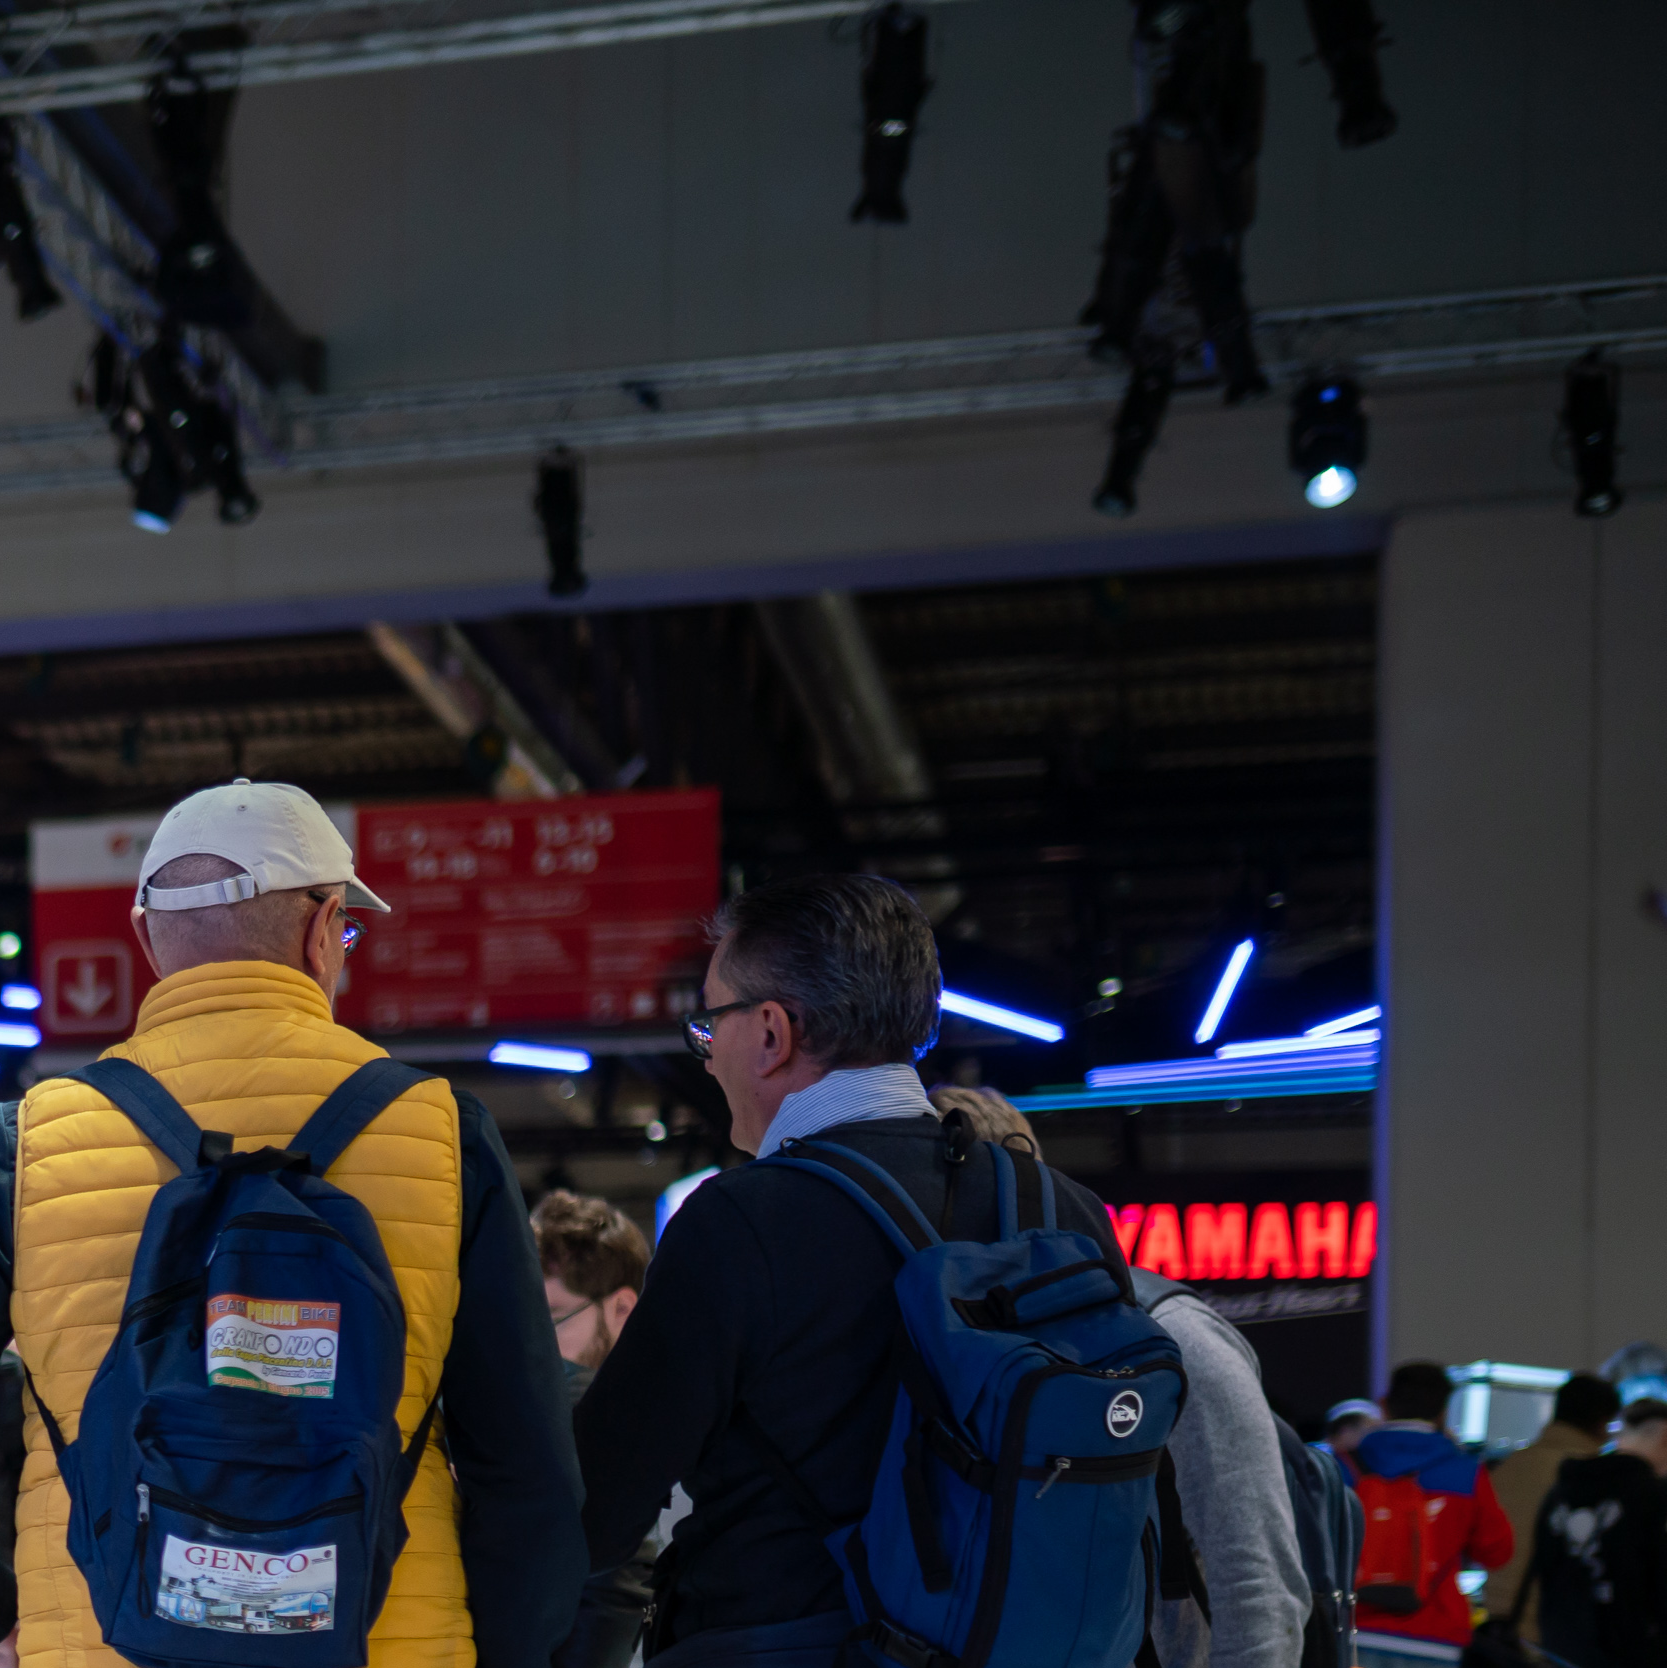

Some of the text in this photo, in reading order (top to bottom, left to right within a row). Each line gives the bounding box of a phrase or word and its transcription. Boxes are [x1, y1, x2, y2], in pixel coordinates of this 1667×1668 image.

[210, 1300, 337, 1326] TEAM PERINI BIKE
[185, 1546, 309, 1576] GEN.CO
